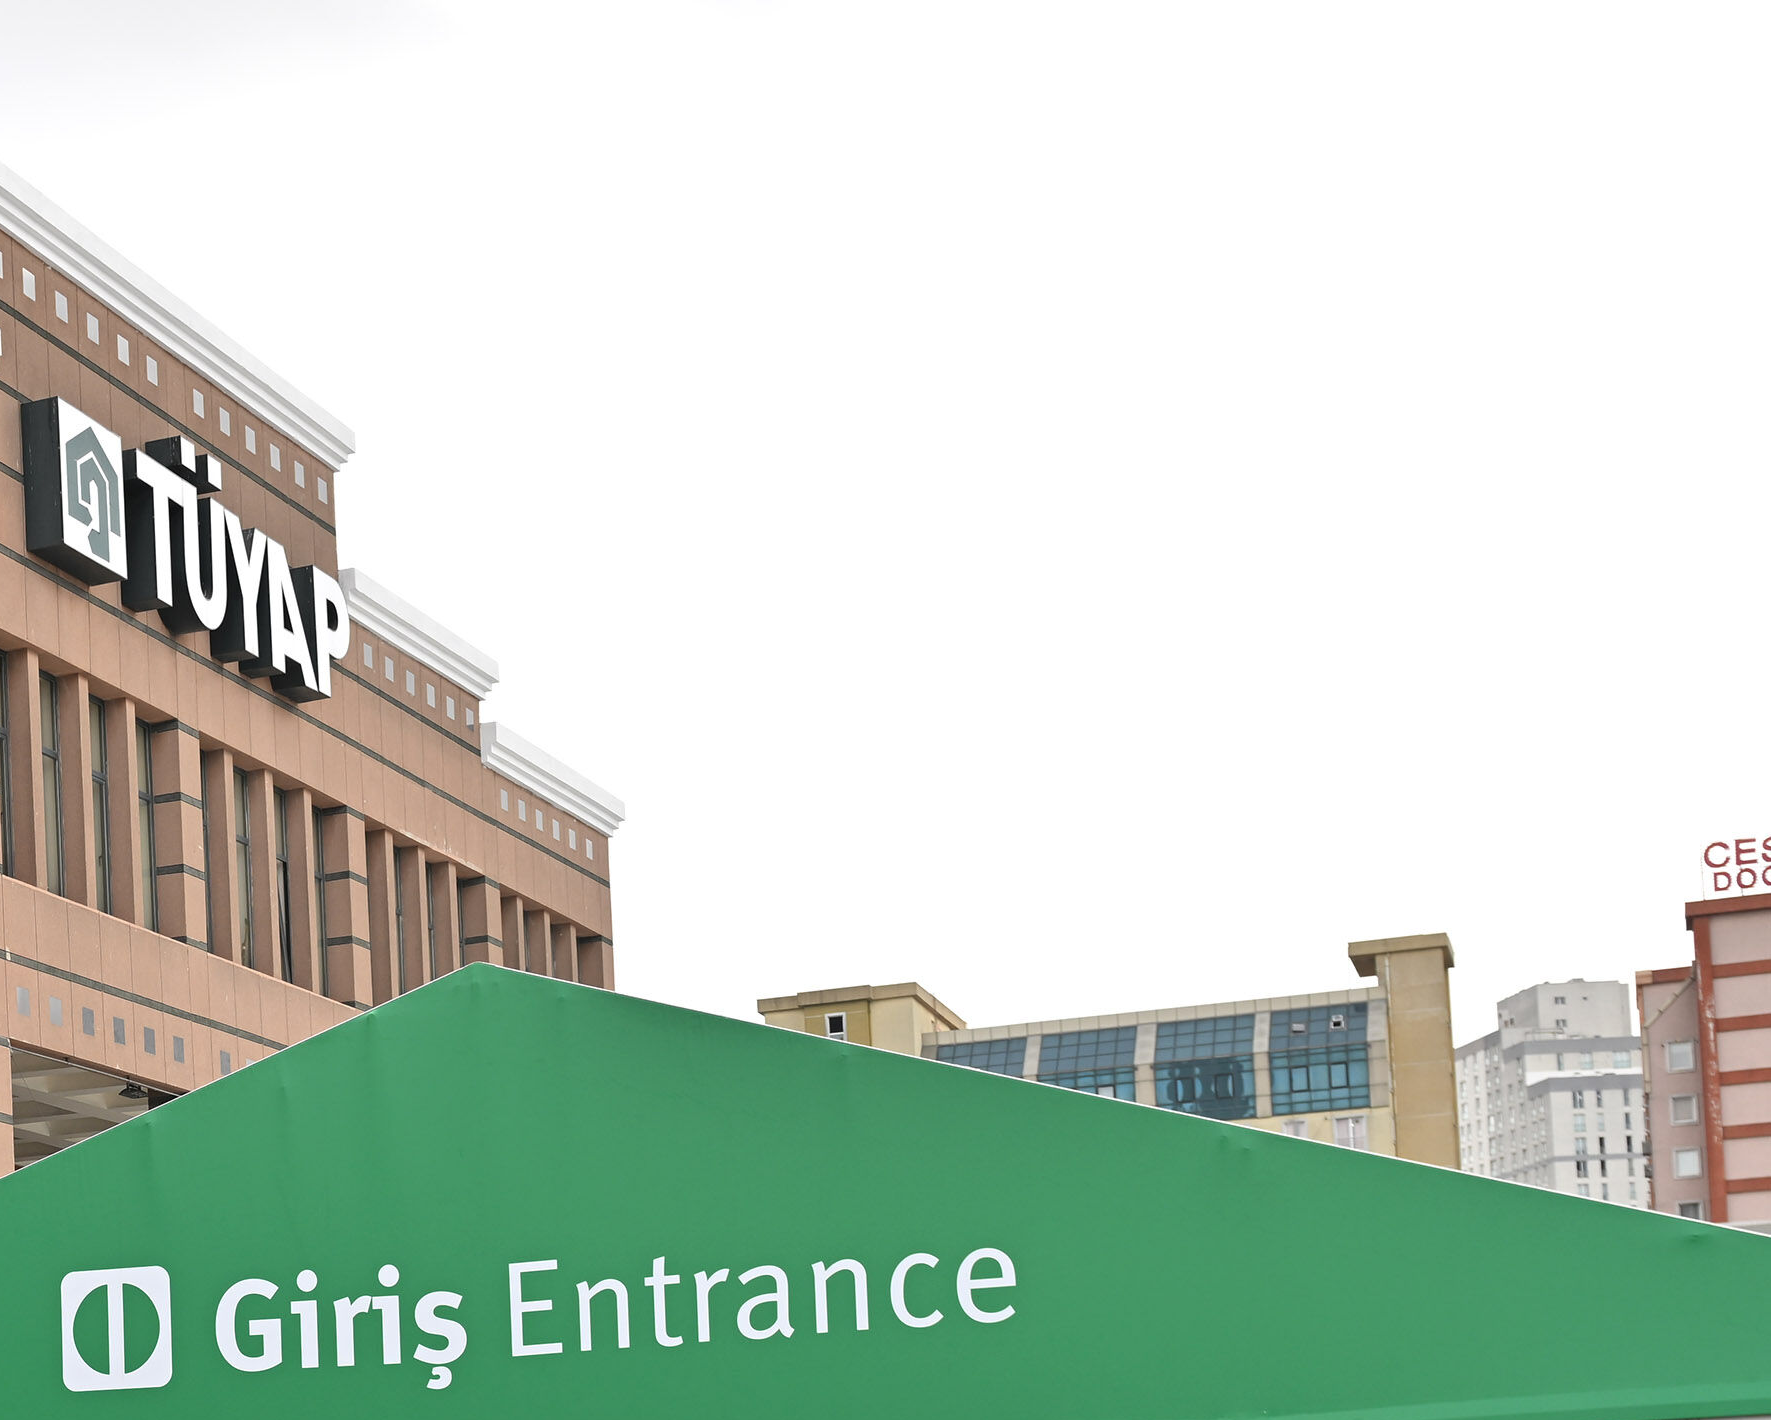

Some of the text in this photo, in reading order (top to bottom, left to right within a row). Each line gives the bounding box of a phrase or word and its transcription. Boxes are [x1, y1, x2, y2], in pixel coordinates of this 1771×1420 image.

[135, 435, 351, 698] TÜYAP
[215, 1246, 1018, 1390] Giriş Entrance
